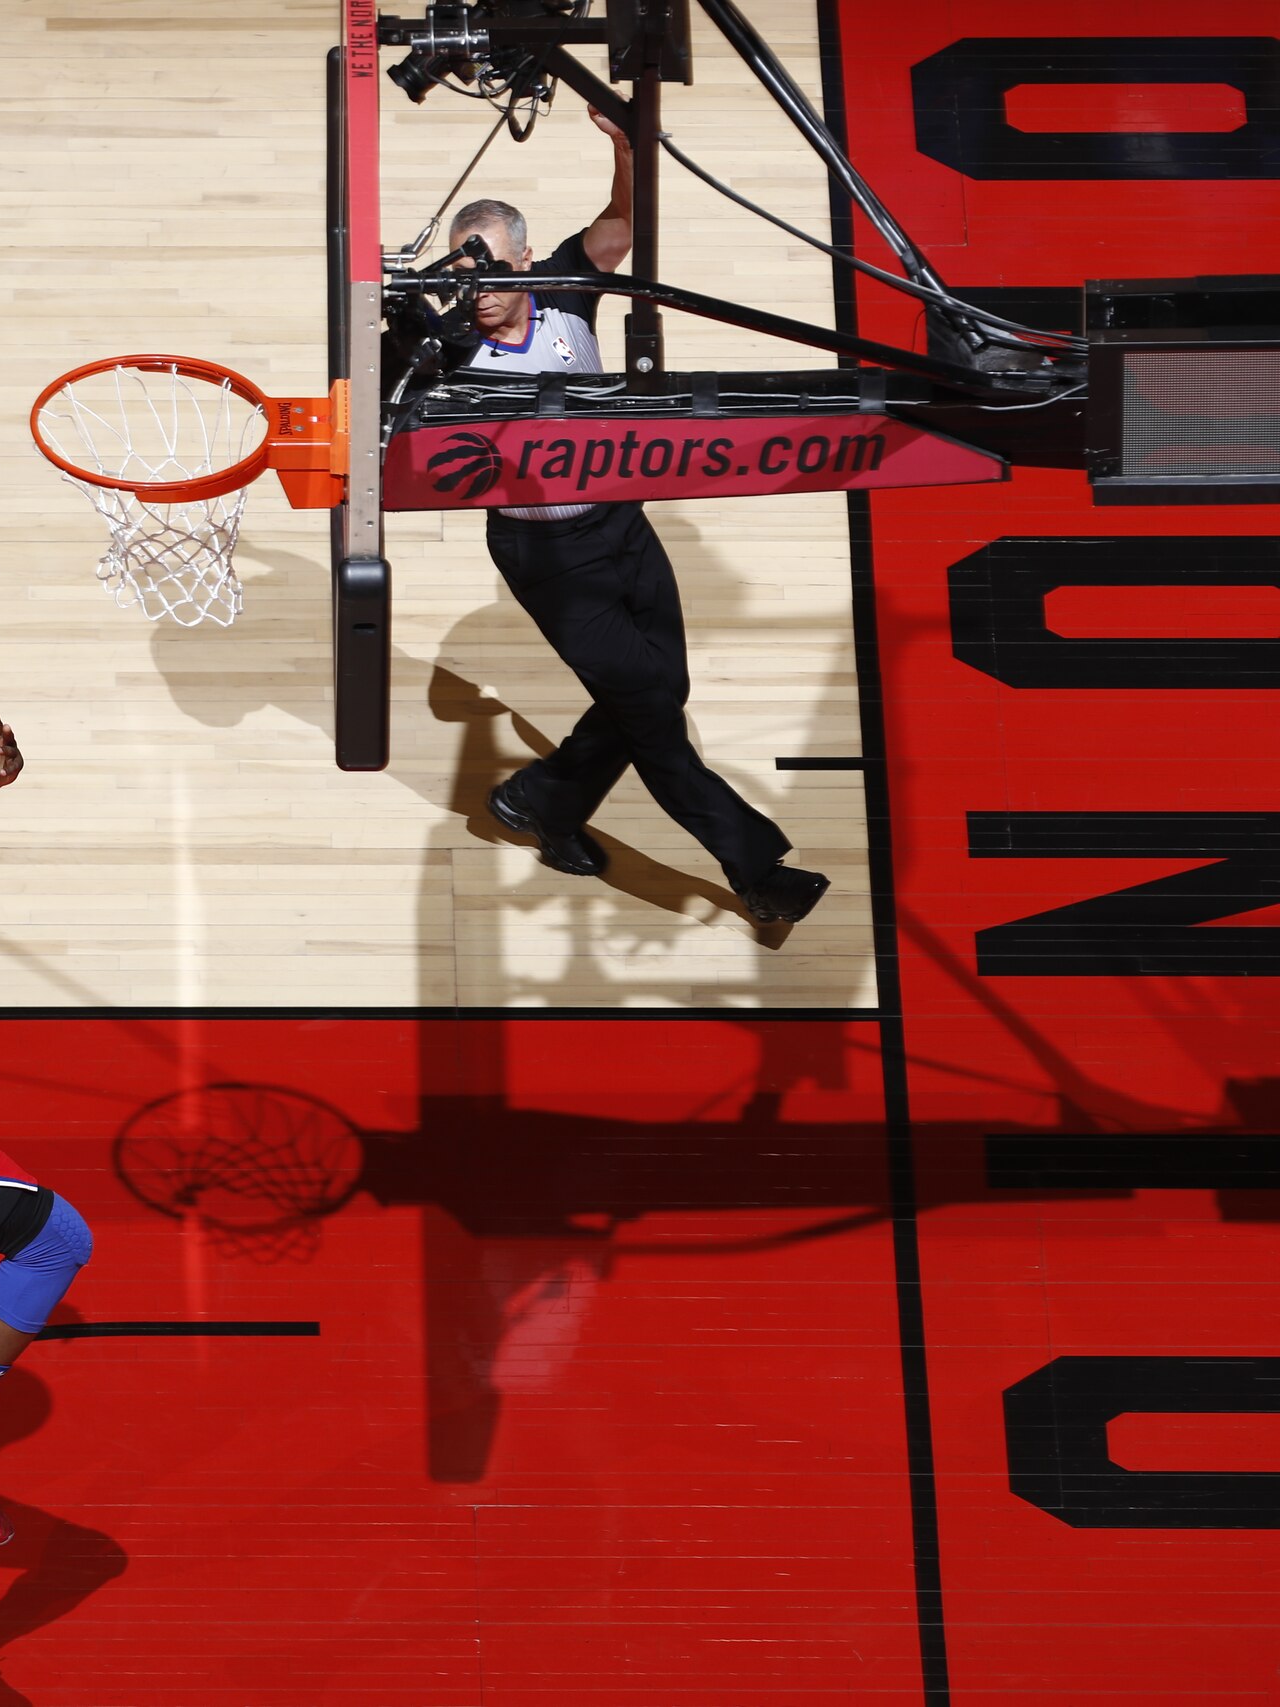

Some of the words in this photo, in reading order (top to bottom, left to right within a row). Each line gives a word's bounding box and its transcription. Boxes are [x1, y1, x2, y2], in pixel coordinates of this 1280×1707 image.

[350, 33, 374, 57] THE
[351, 63, 374, 78] WE
[277, 402, 293, 435] SPALDING
[516, 430, 886, 491] raptors.com
